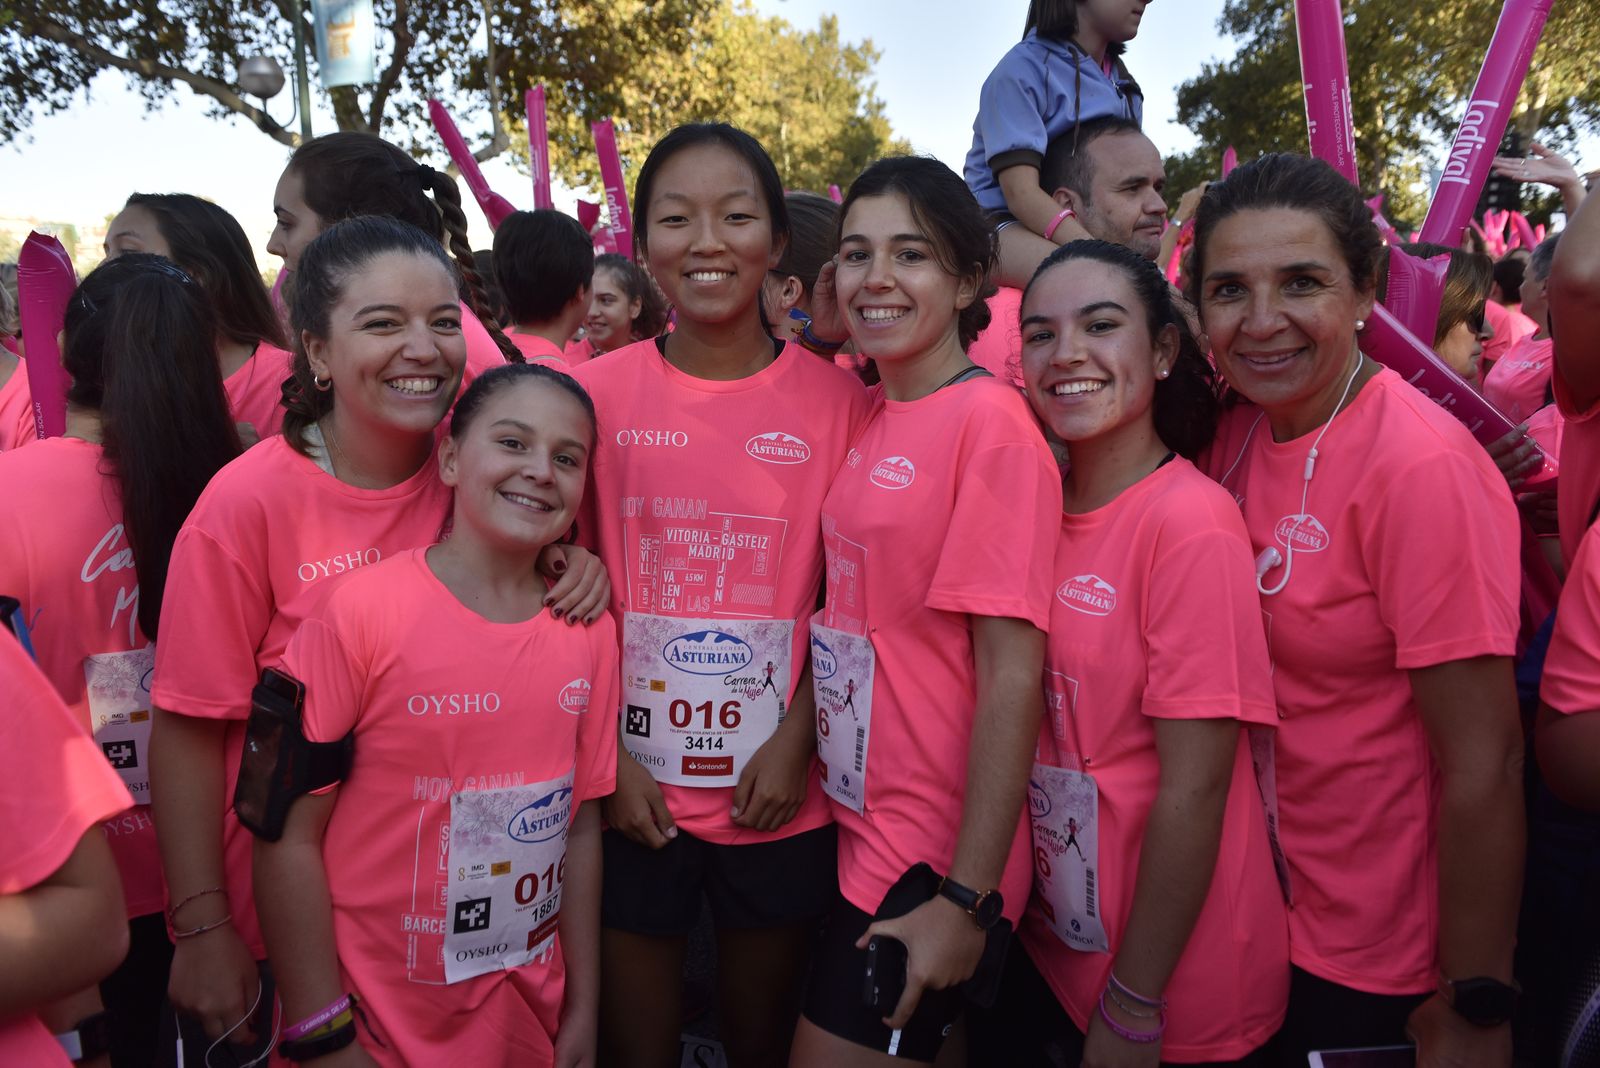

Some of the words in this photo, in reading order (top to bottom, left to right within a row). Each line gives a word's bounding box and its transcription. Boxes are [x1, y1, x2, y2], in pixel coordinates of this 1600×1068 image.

[617, 430, 688, 448] OYSHO
[750, 441, 805, 459] ASTURIANA
[653, 497, 708, 520] GANAN
[667, 529, 711, 544] VITORIA
[722, 533, 768, 549] GASTEIZ
[688, 545, 735, 560] MADRID
[298, 548, 380, 582] OYSHO
[663, 570, 675, 582] VA
[662, 584, 681, 597] LEN
[661, 597, 676, 610] CIA
[687, 596, 711, 612] LAS
[669, 645, 746, 664] ASTURIANA
[724, 675, 757, 687] Carrera
[742, 685, 765, 701] Mujer
[407, 692, 501, 716] OYSHO
[669, 699, 742, 730] 016
[685, 736, 724, 750] 3414
[127, 782, 149, 793] YSH
[836, 785, 857, 801] ZURICH
[105, 812, 152, 837] YSH
[471, 864, 485, 872] IMD
[532, 894, 559, 922] 1887
[404, 916, 446, 934] BARCE
[456, 943, 508, 963] OYSHO
